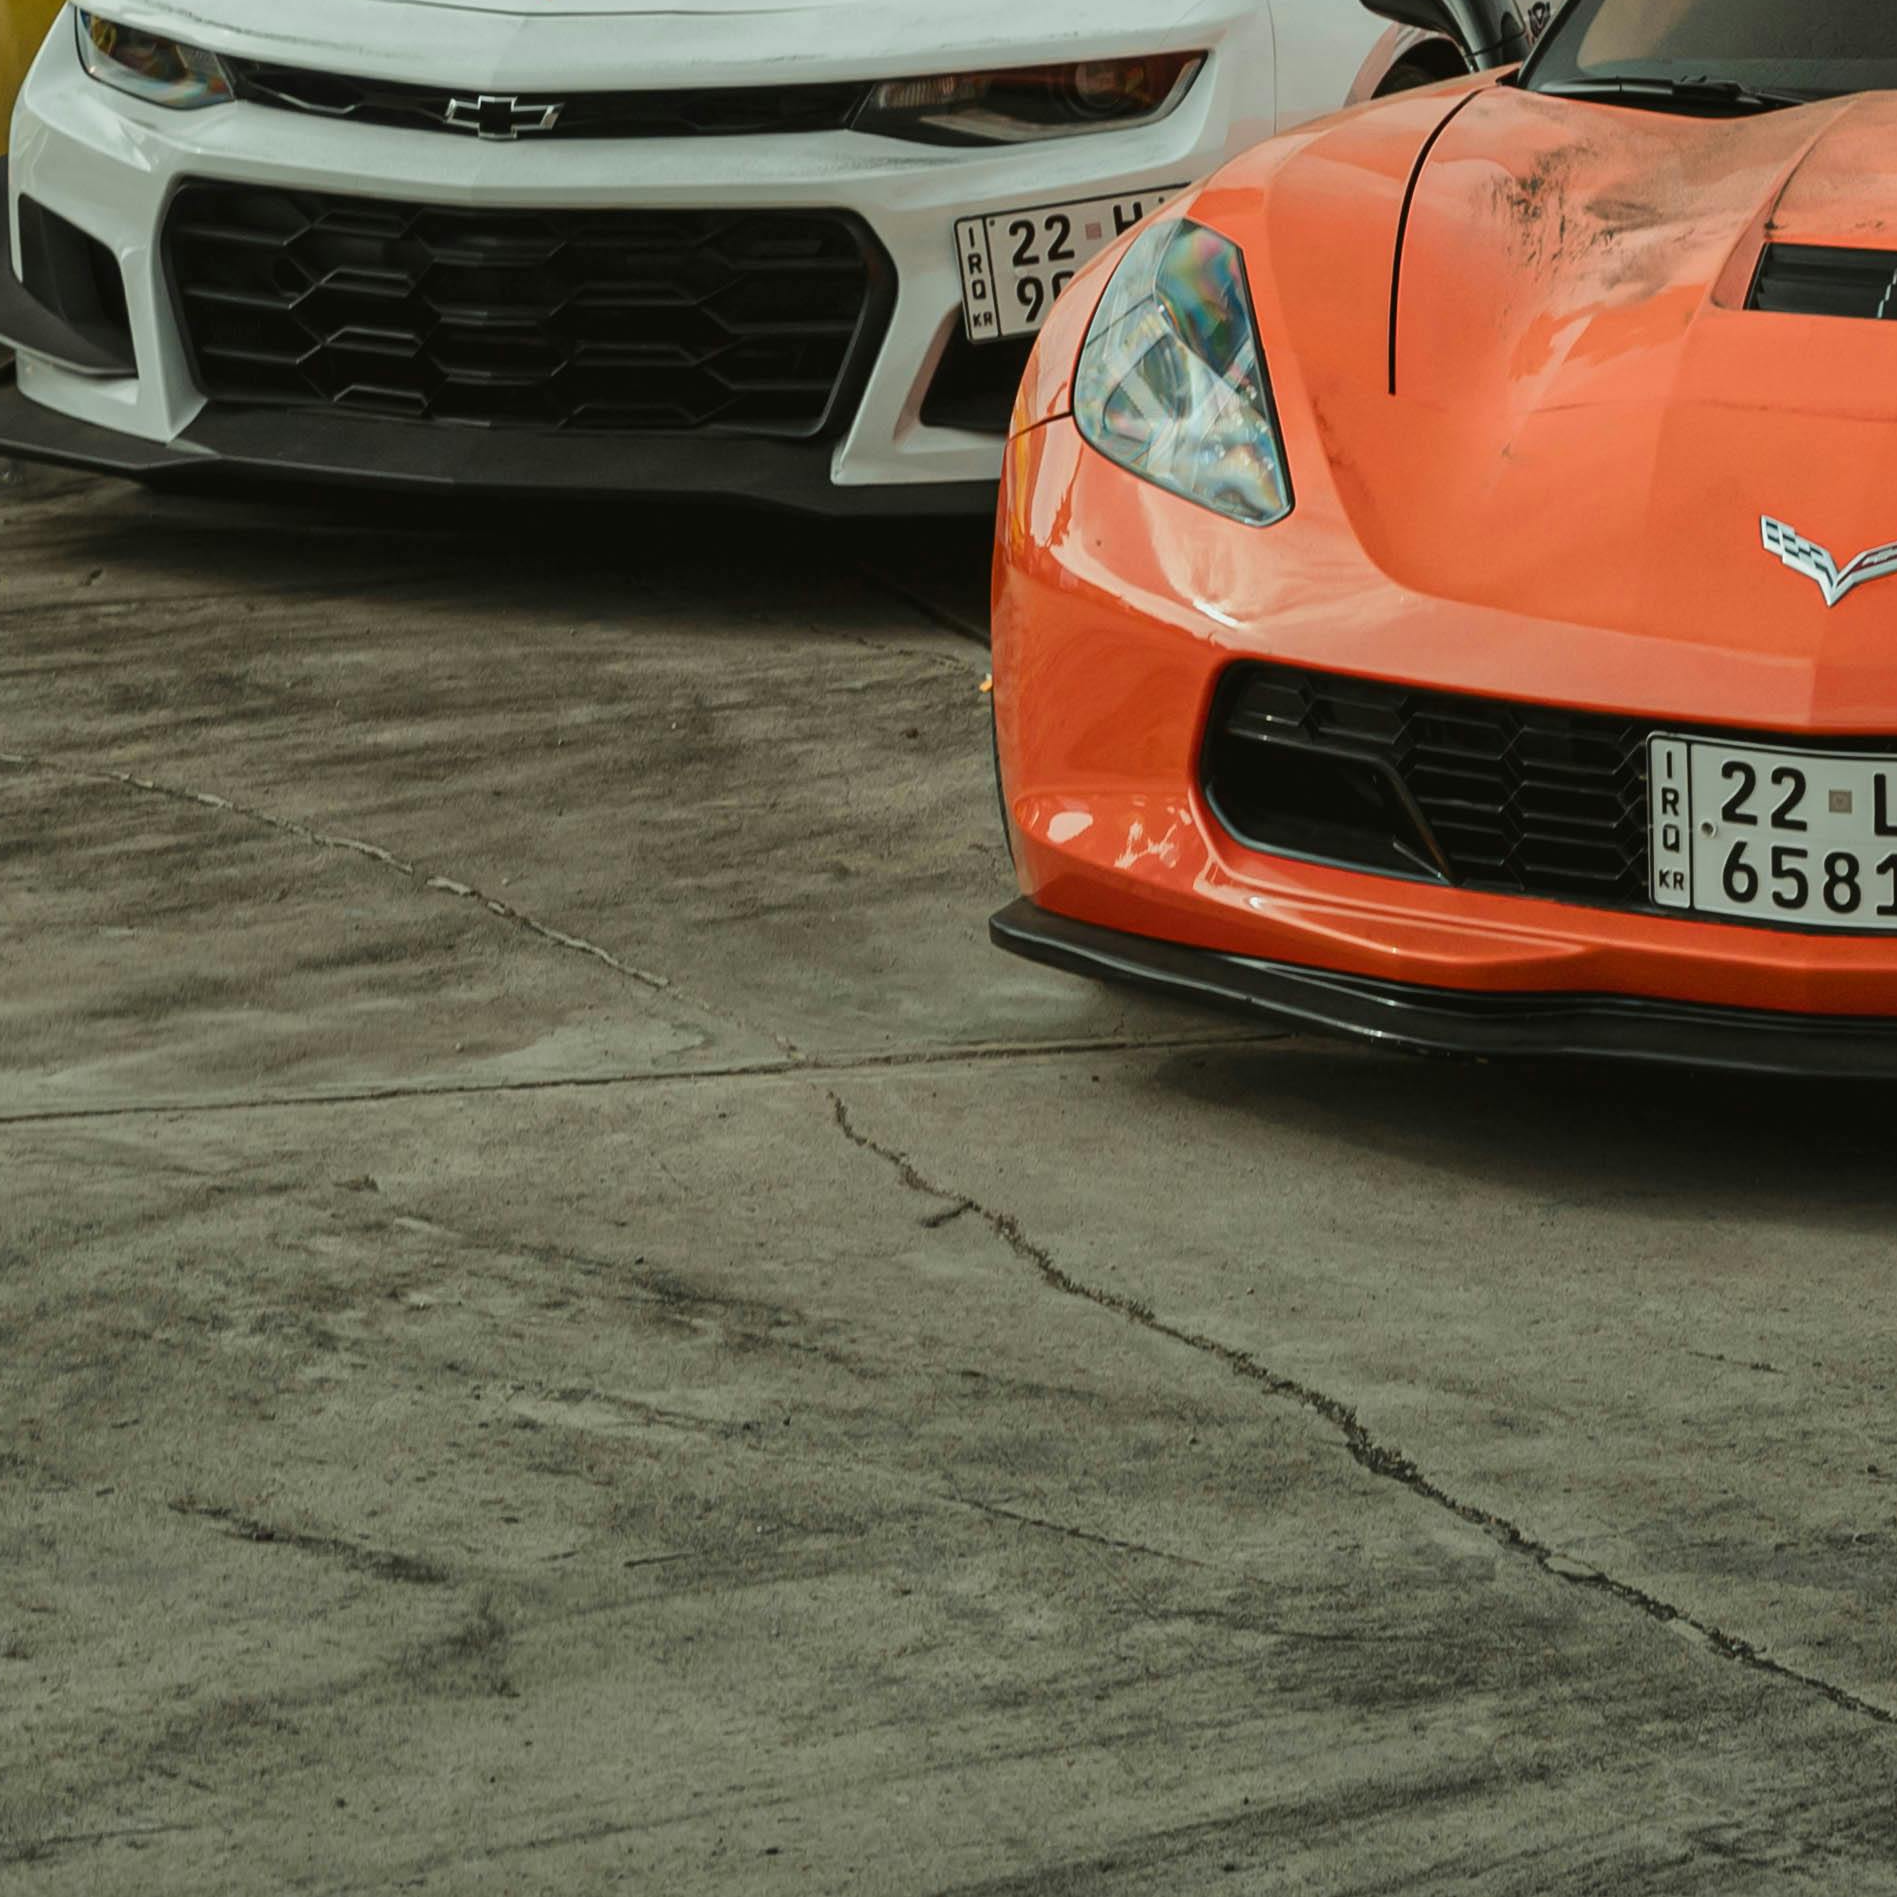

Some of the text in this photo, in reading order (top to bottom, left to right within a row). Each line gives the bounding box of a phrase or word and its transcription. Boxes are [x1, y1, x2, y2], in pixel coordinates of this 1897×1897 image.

[1009, 214, 1075, 267] 22
[1721, 761, 1807, 832] 22
[1659, 870, 1684, 891] KR
